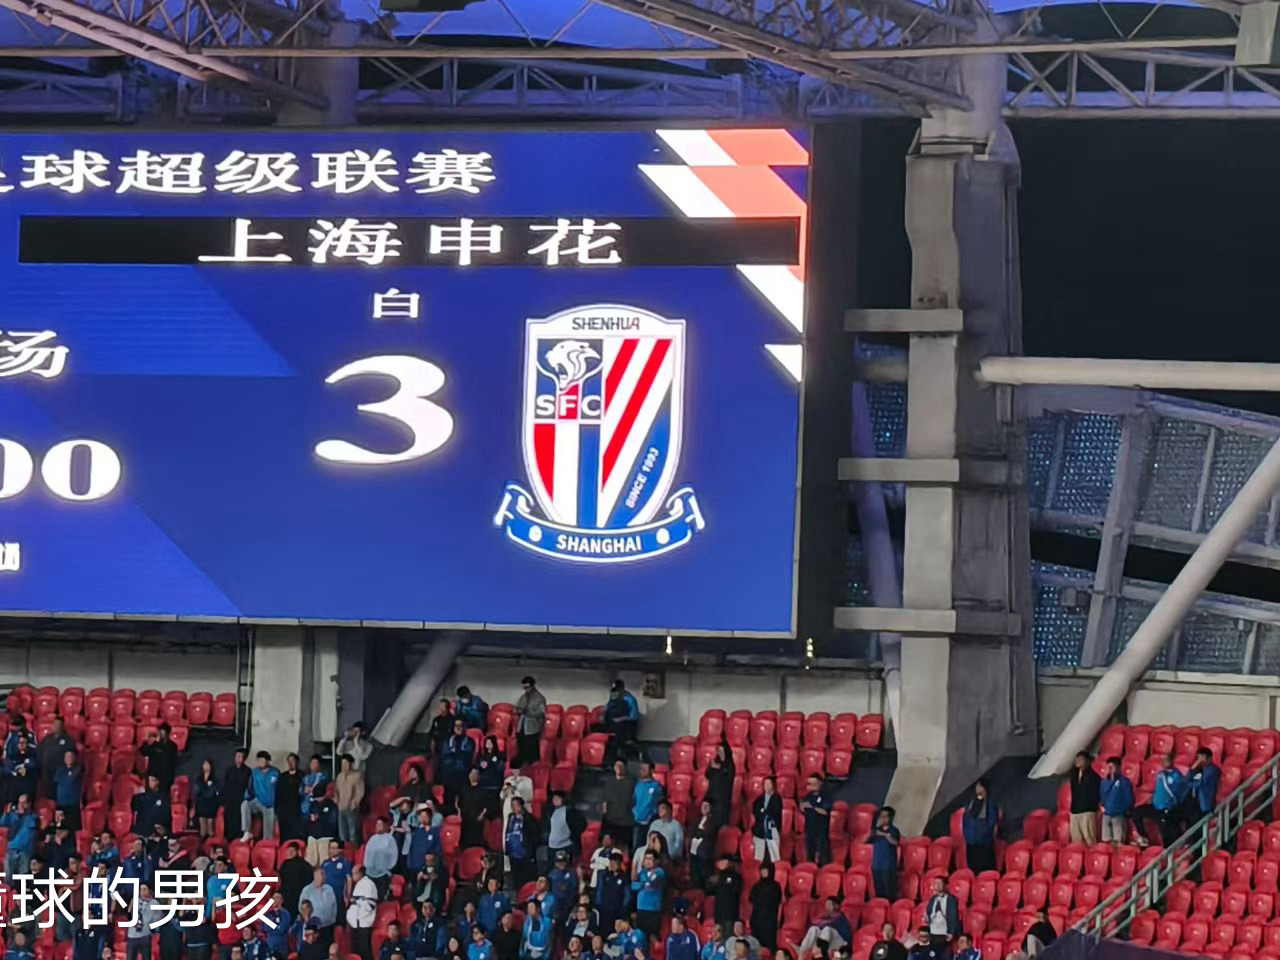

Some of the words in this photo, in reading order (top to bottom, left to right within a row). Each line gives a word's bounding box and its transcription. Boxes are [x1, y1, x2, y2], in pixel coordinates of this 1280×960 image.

[197, 217, 622, 266] 上海申花
[372, 287, 420, 319] 白
[571, 317, 640, 331] SHENHUA
[314, 355, 455, 465] 3
[535, 394, 602, 417] SFC
[625, 473, 647, 509] SINCE
[555, 535, 642, 554] SHANGHAI
